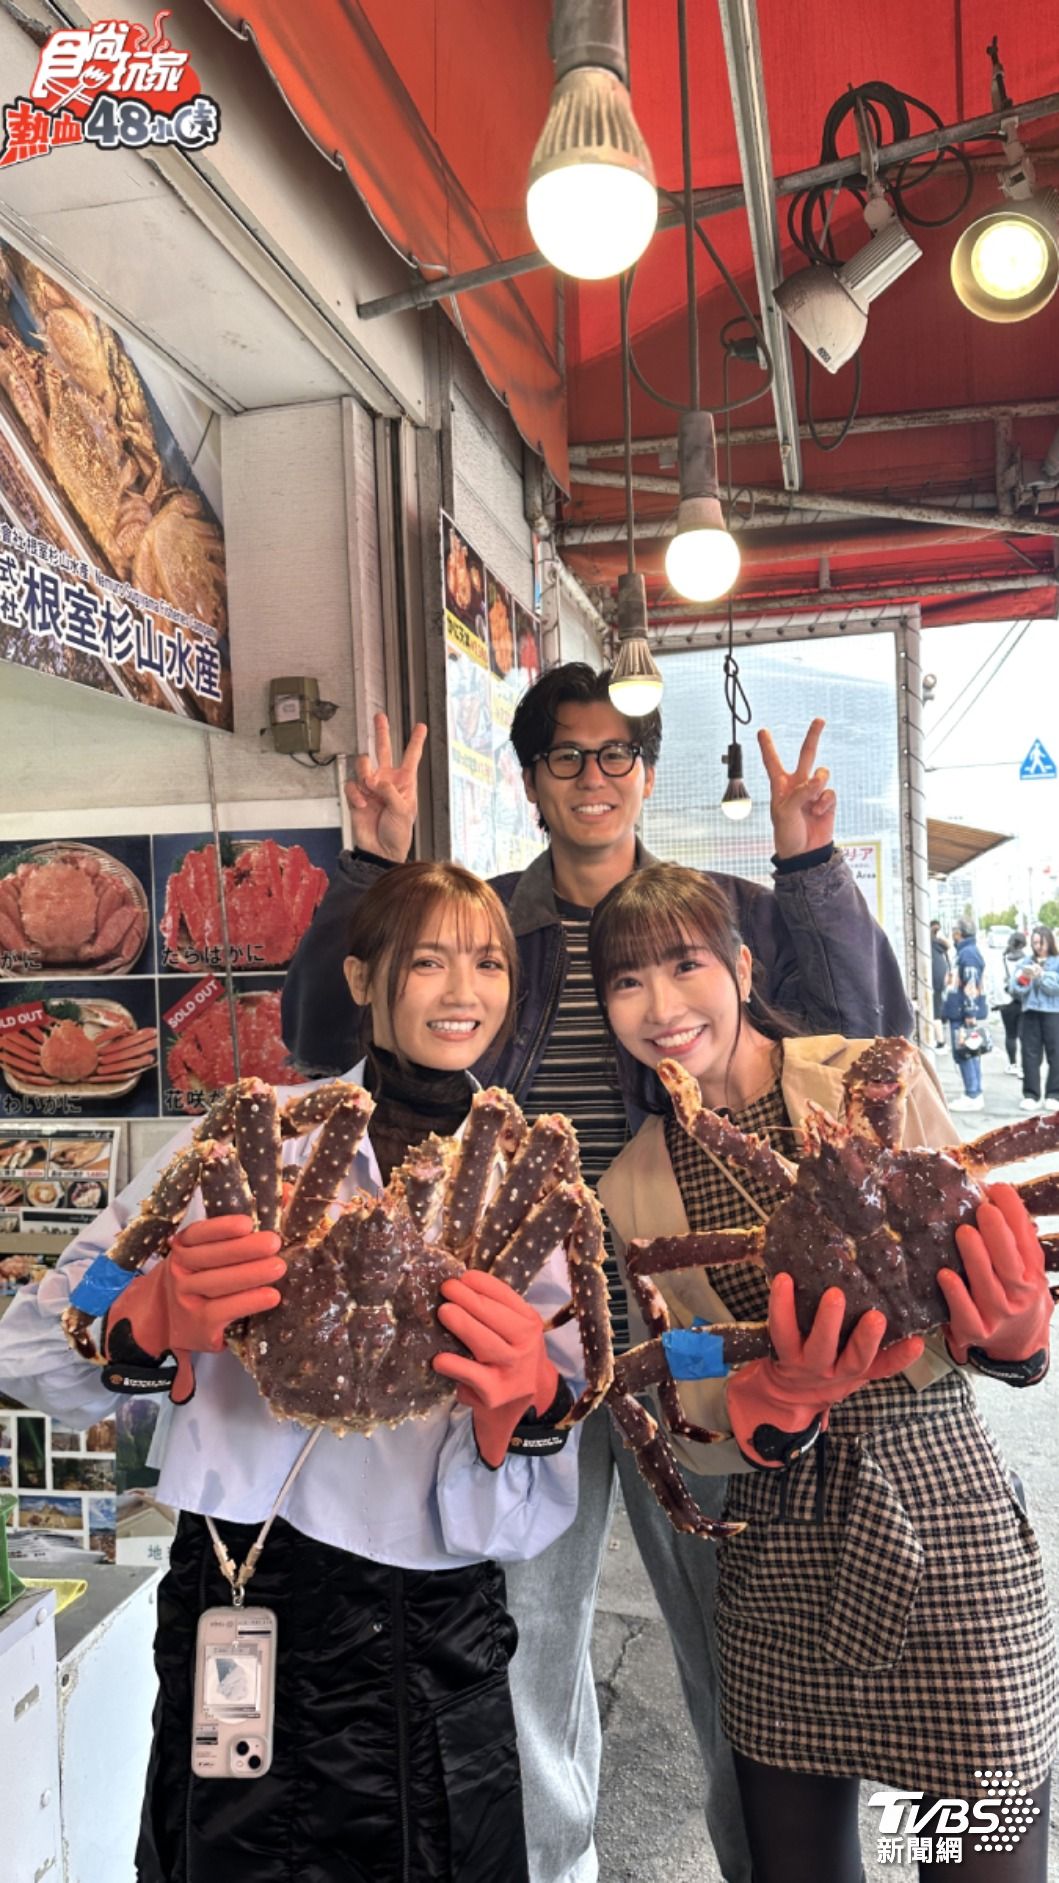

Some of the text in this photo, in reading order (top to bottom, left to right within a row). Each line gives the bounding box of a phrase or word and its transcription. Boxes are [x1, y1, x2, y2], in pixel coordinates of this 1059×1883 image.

[22, 563, 222, 701] 根室杉山水産
[17, 1009, 43, 1024] OUT
[167, 979, 219, 1030] SOLD OUT
